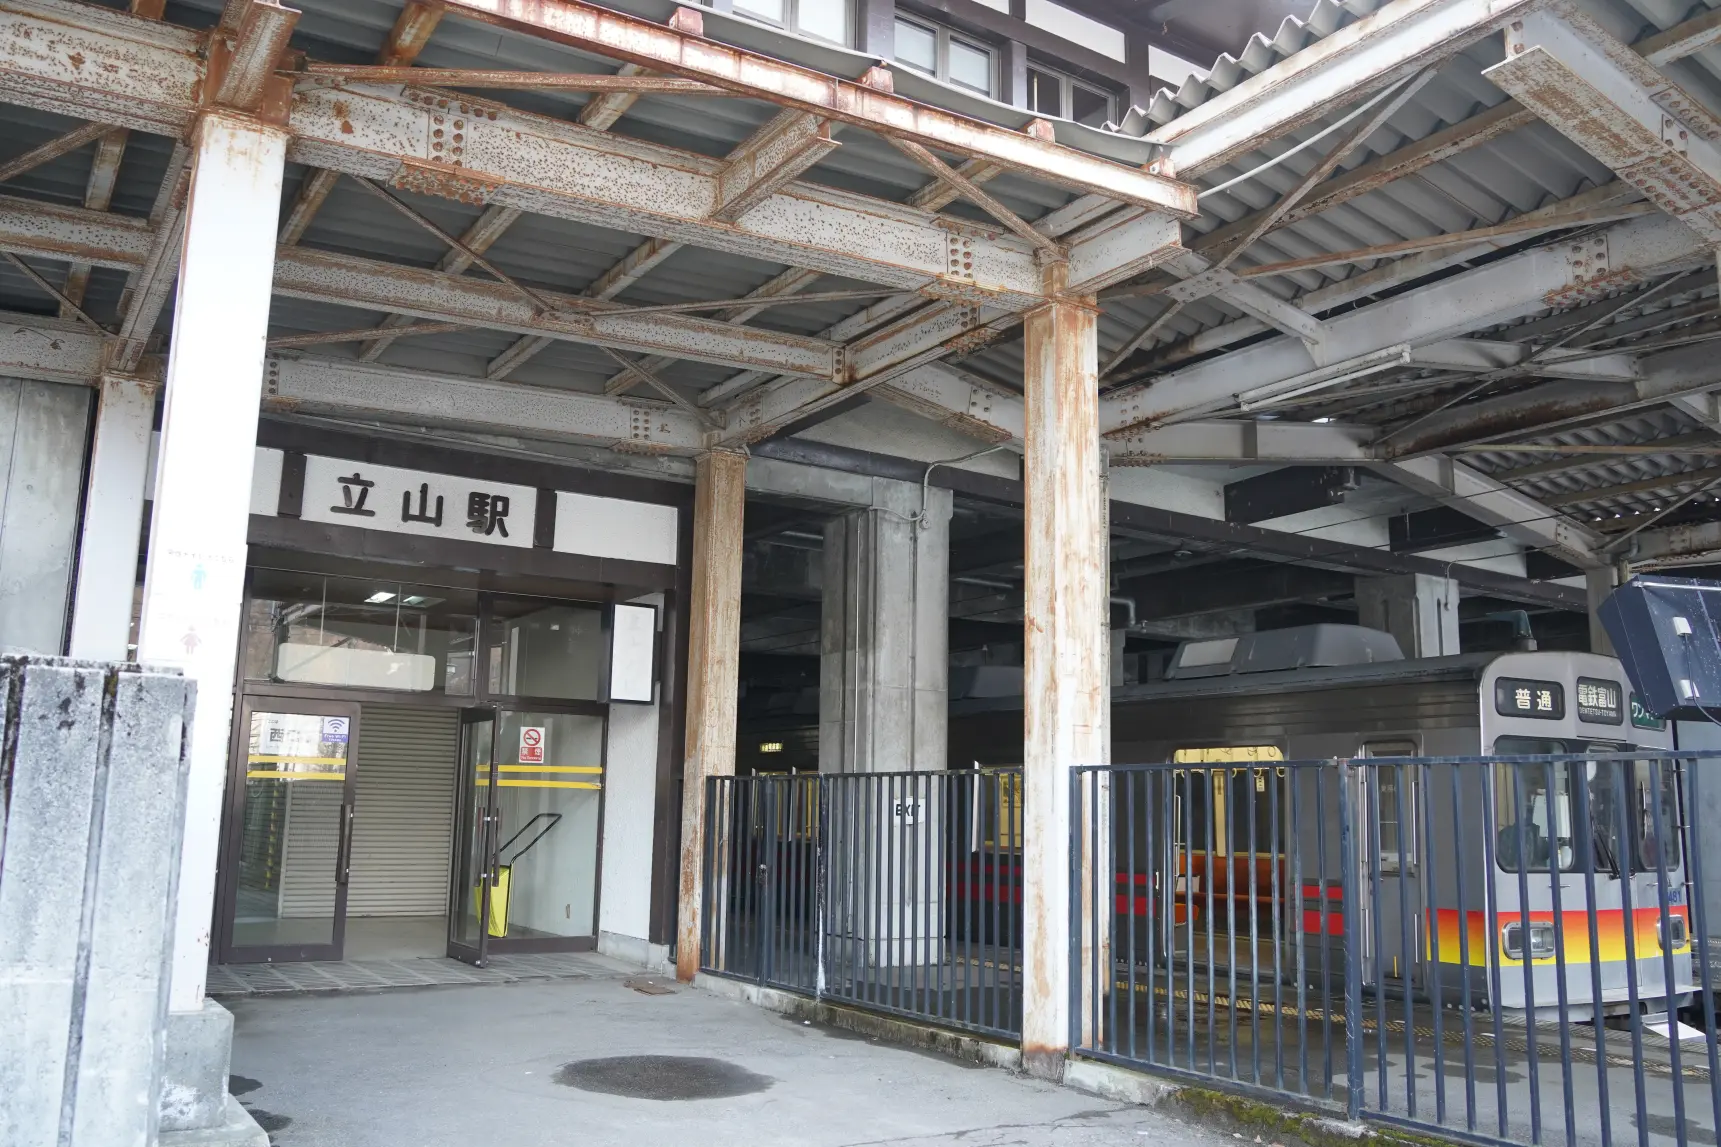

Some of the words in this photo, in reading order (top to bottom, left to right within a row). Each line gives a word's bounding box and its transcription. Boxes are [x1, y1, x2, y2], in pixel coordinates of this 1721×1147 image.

[329, 471, 511, 539] 立山駅
[1514, 688, 1553, 711] 普通
[1578, 684, 1616, 709] 電鉄富山
